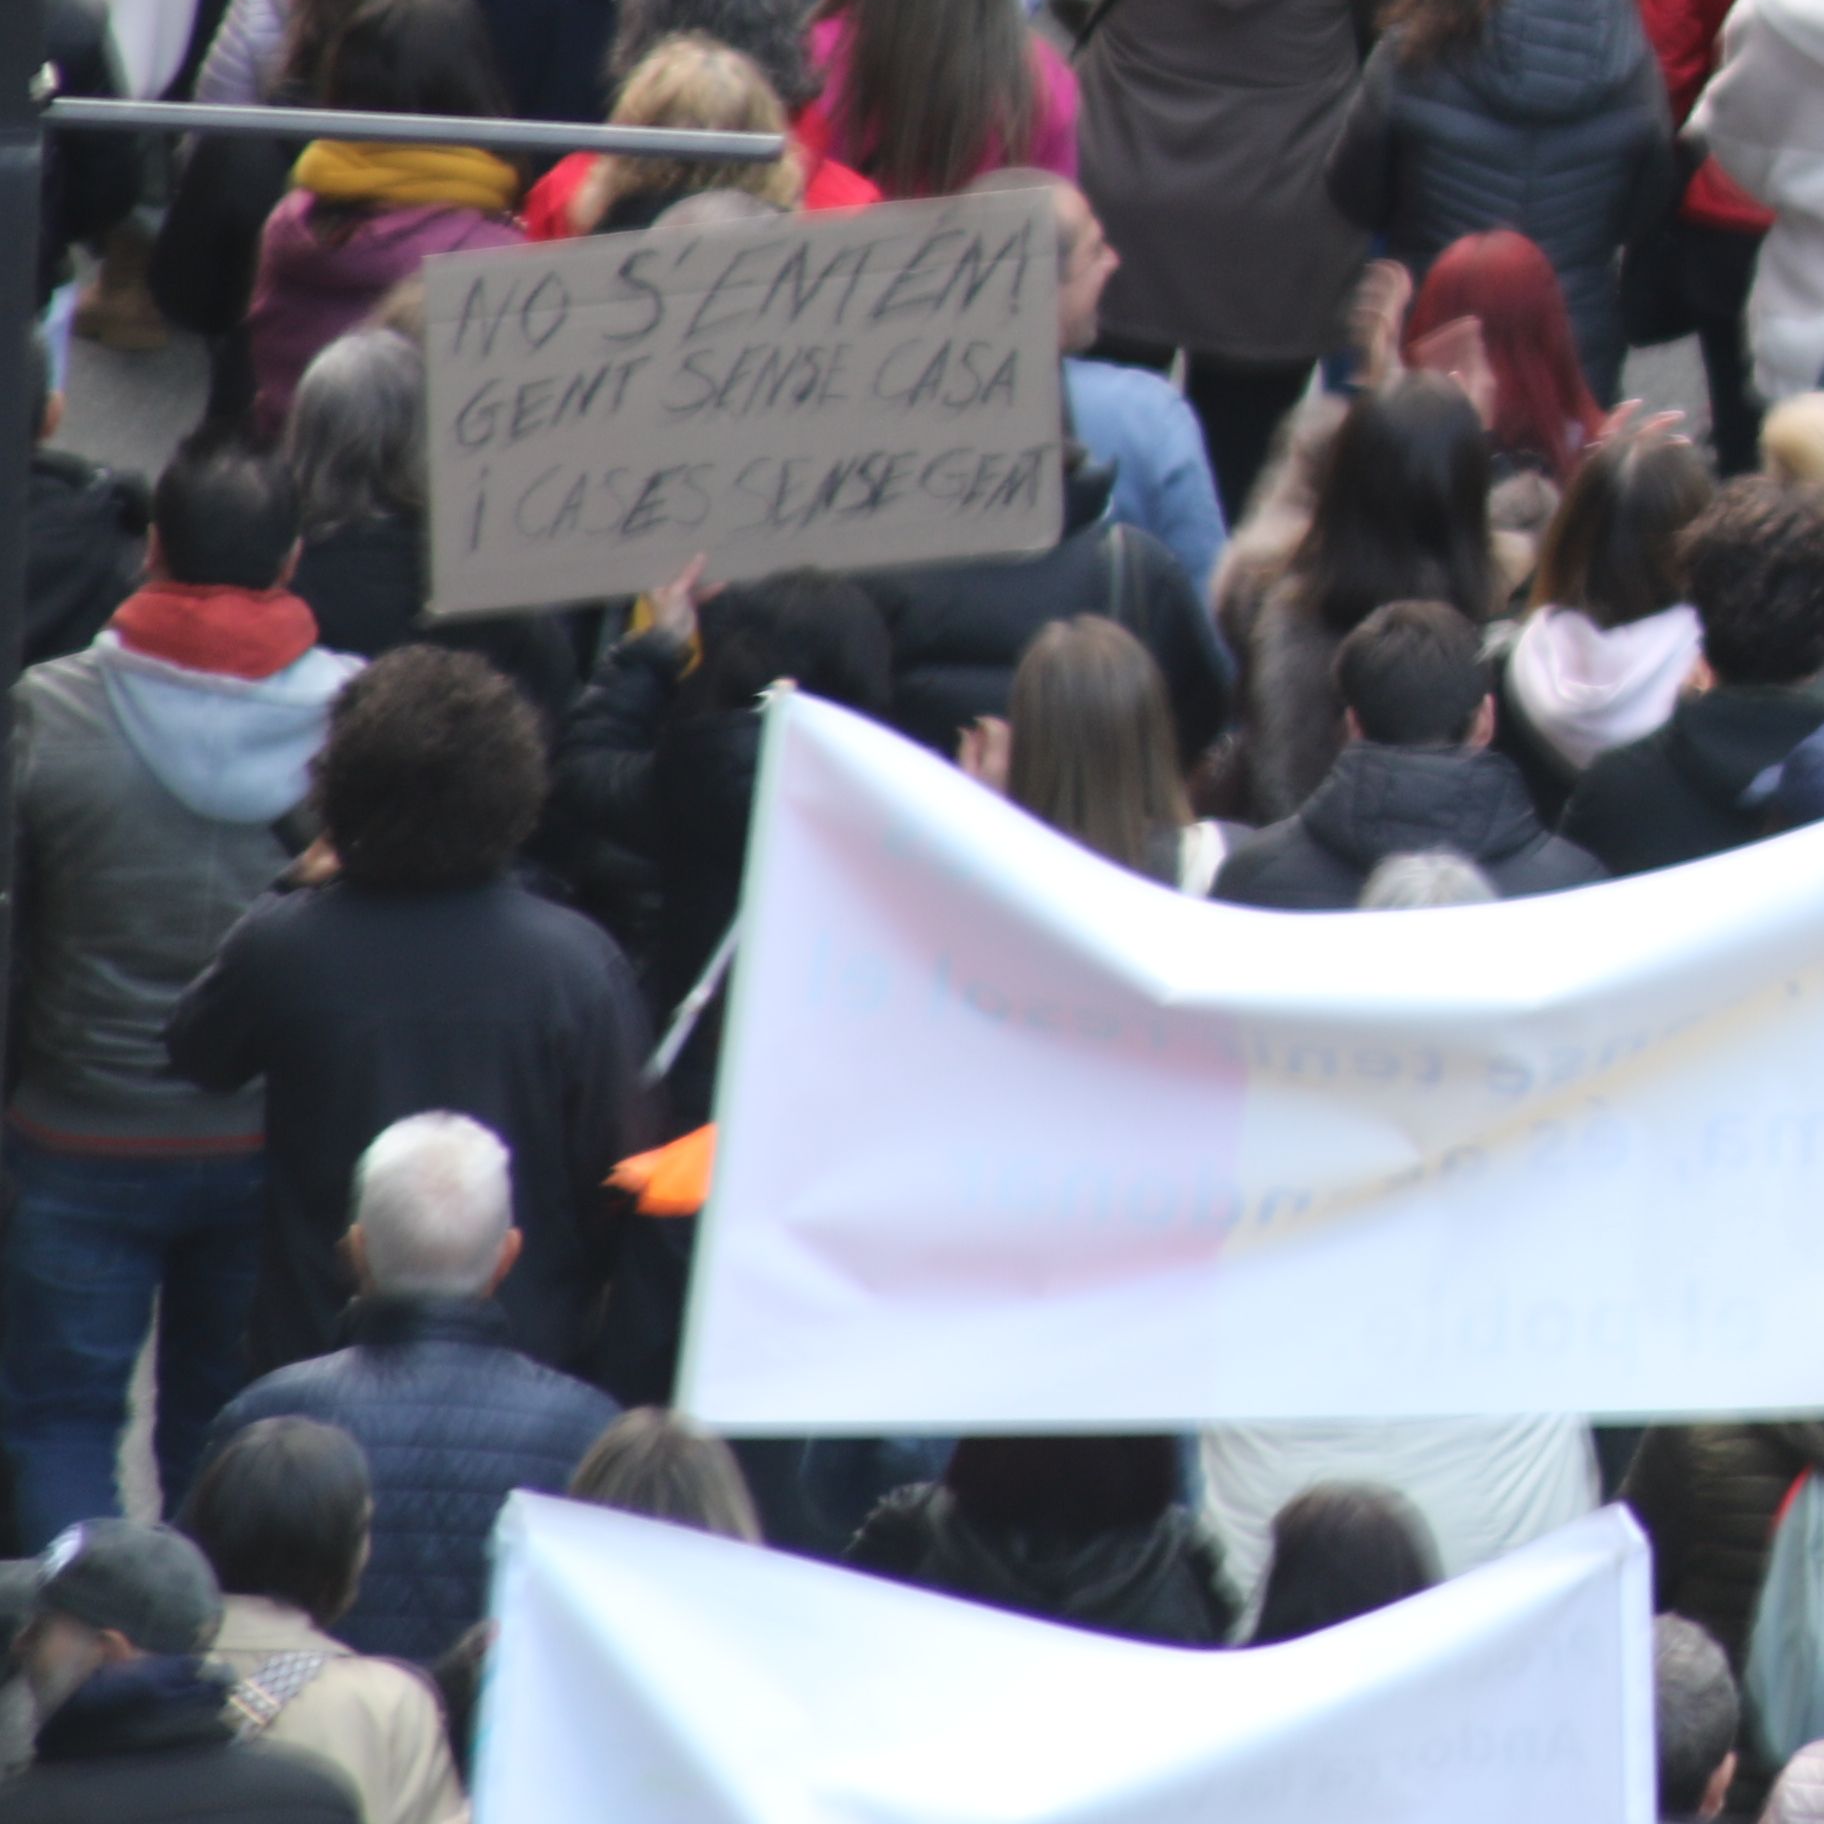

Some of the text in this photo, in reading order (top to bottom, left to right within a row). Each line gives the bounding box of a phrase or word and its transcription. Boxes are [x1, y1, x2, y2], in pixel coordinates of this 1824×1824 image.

[453, 270, 573, 360] NO
[455, 337, 1020, 450] GENT SENSE CASA
[514, 462, 716, 539] CASES
[731, 449, 920, 534] SENSE
[917, 442, 1058, 512] GENT
